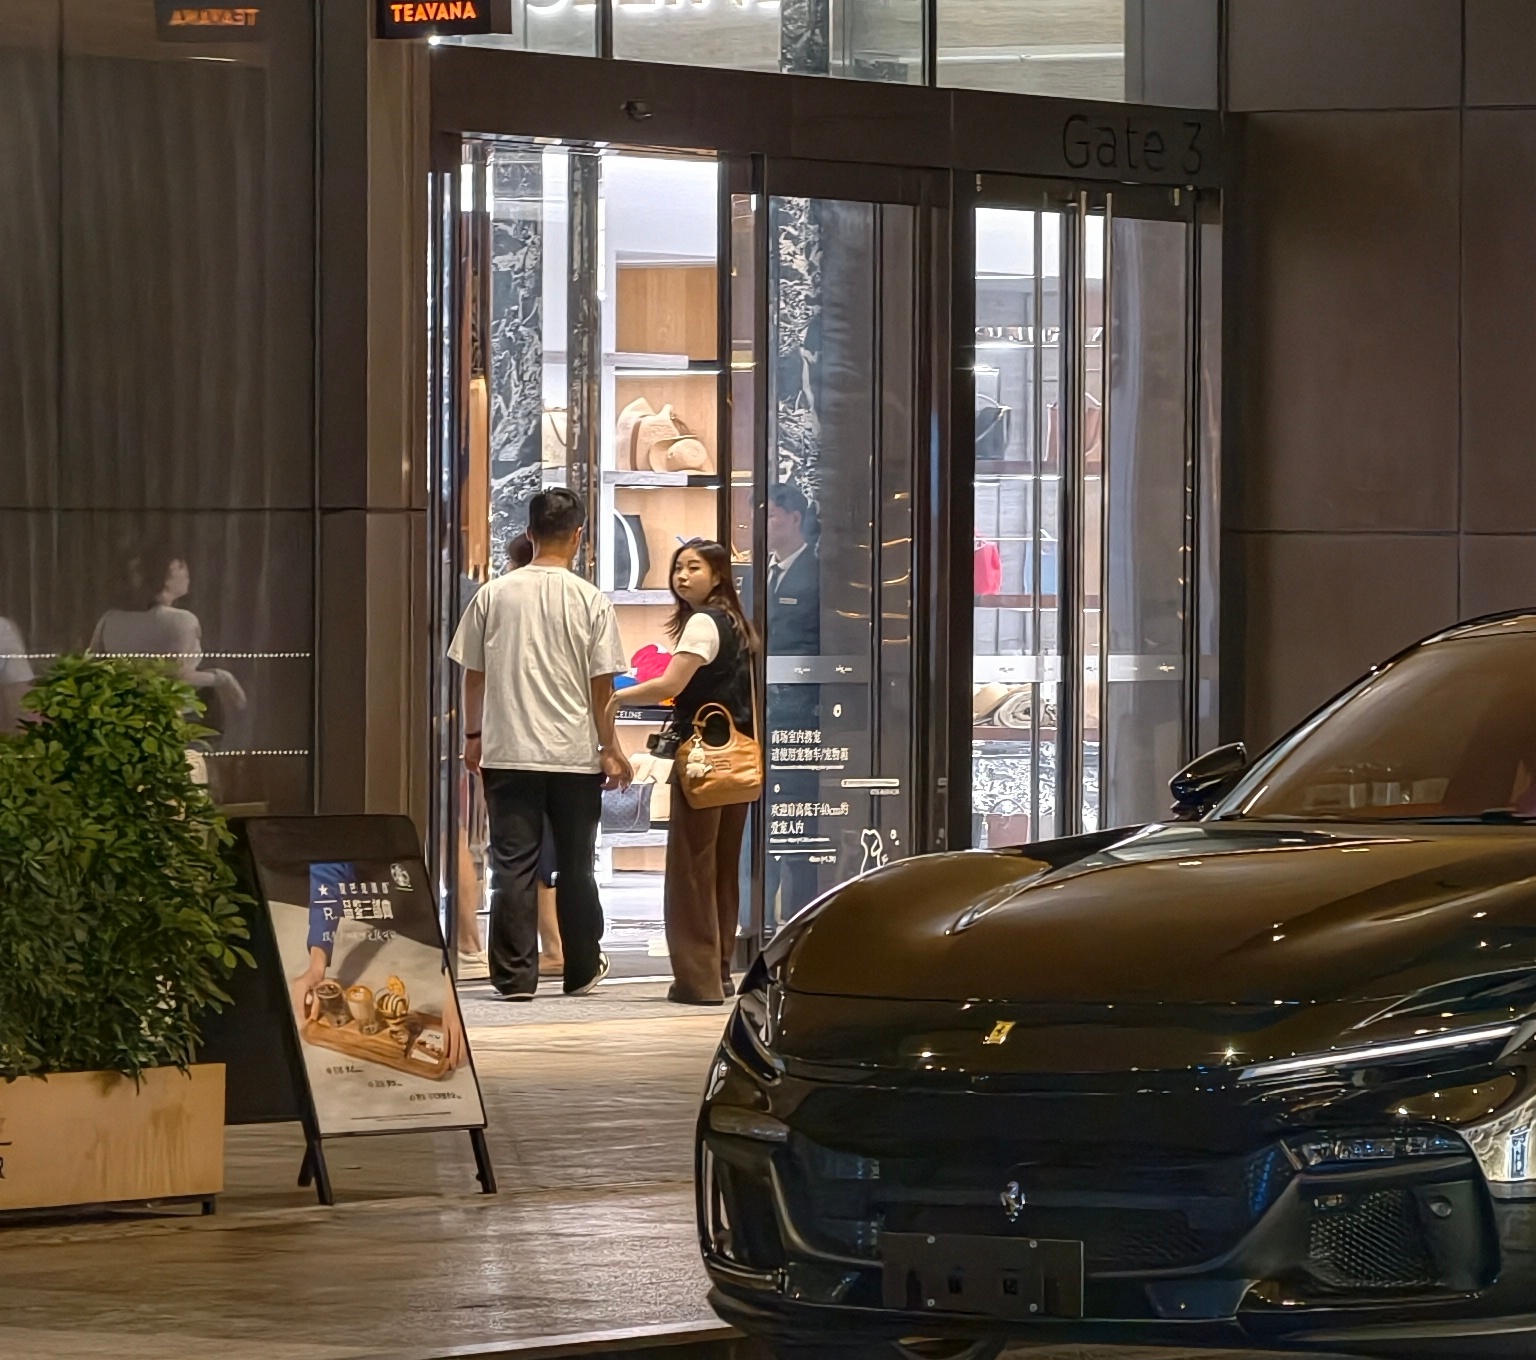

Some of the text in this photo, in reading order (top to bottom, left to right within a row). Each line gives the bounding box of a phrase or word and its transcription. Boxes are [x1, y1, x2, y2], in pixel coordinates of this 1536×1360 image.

[390, 1, 477, 23] TEAVANA
[1063, 114, 1202, 175] Gate 3
